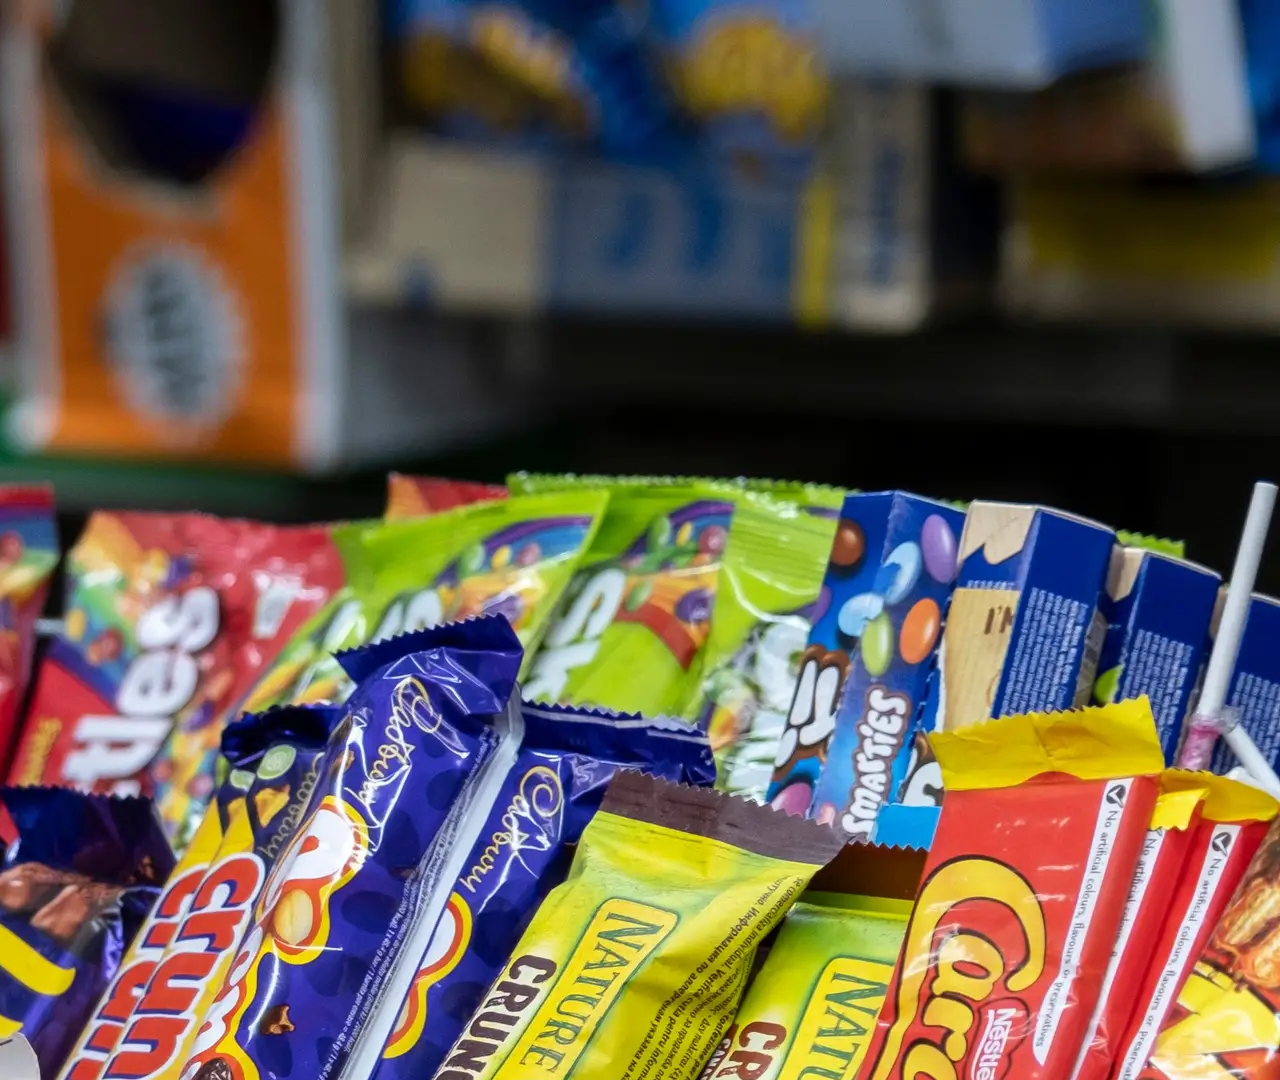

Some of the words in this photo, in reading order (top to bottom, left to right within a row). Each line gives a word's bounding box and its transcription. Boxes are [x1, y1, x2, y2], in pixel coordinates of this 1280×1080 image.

[346, 677, 443, 815] Cadbury
[842, 686, 908, 836] SMARTIES
[460, 766, 562, 898] Cadbury
[1105, 808, 1118, 823] No
[1089, 831, 1112, 875] artificial
[1141, 836, 1157, 856] No
[1205, 856, 1222, 877] No
[1074, 877, 1098, 921] colours,
[1186, 878, 1214, 924] artificial
[702, 901, 759, 966] Информация
[1062, 921, 1085, 966] flavours
[1166, 924, 1194, 968] colours,
[519, 912, 667, 1077] NATURE
[1149, 968, 1177, 1013] flavours
[652, 1015, 683, 1048] pentru
[1034, 980, 1065, 1048] preservatives
[1144, 1014, 1154, 1026] or
